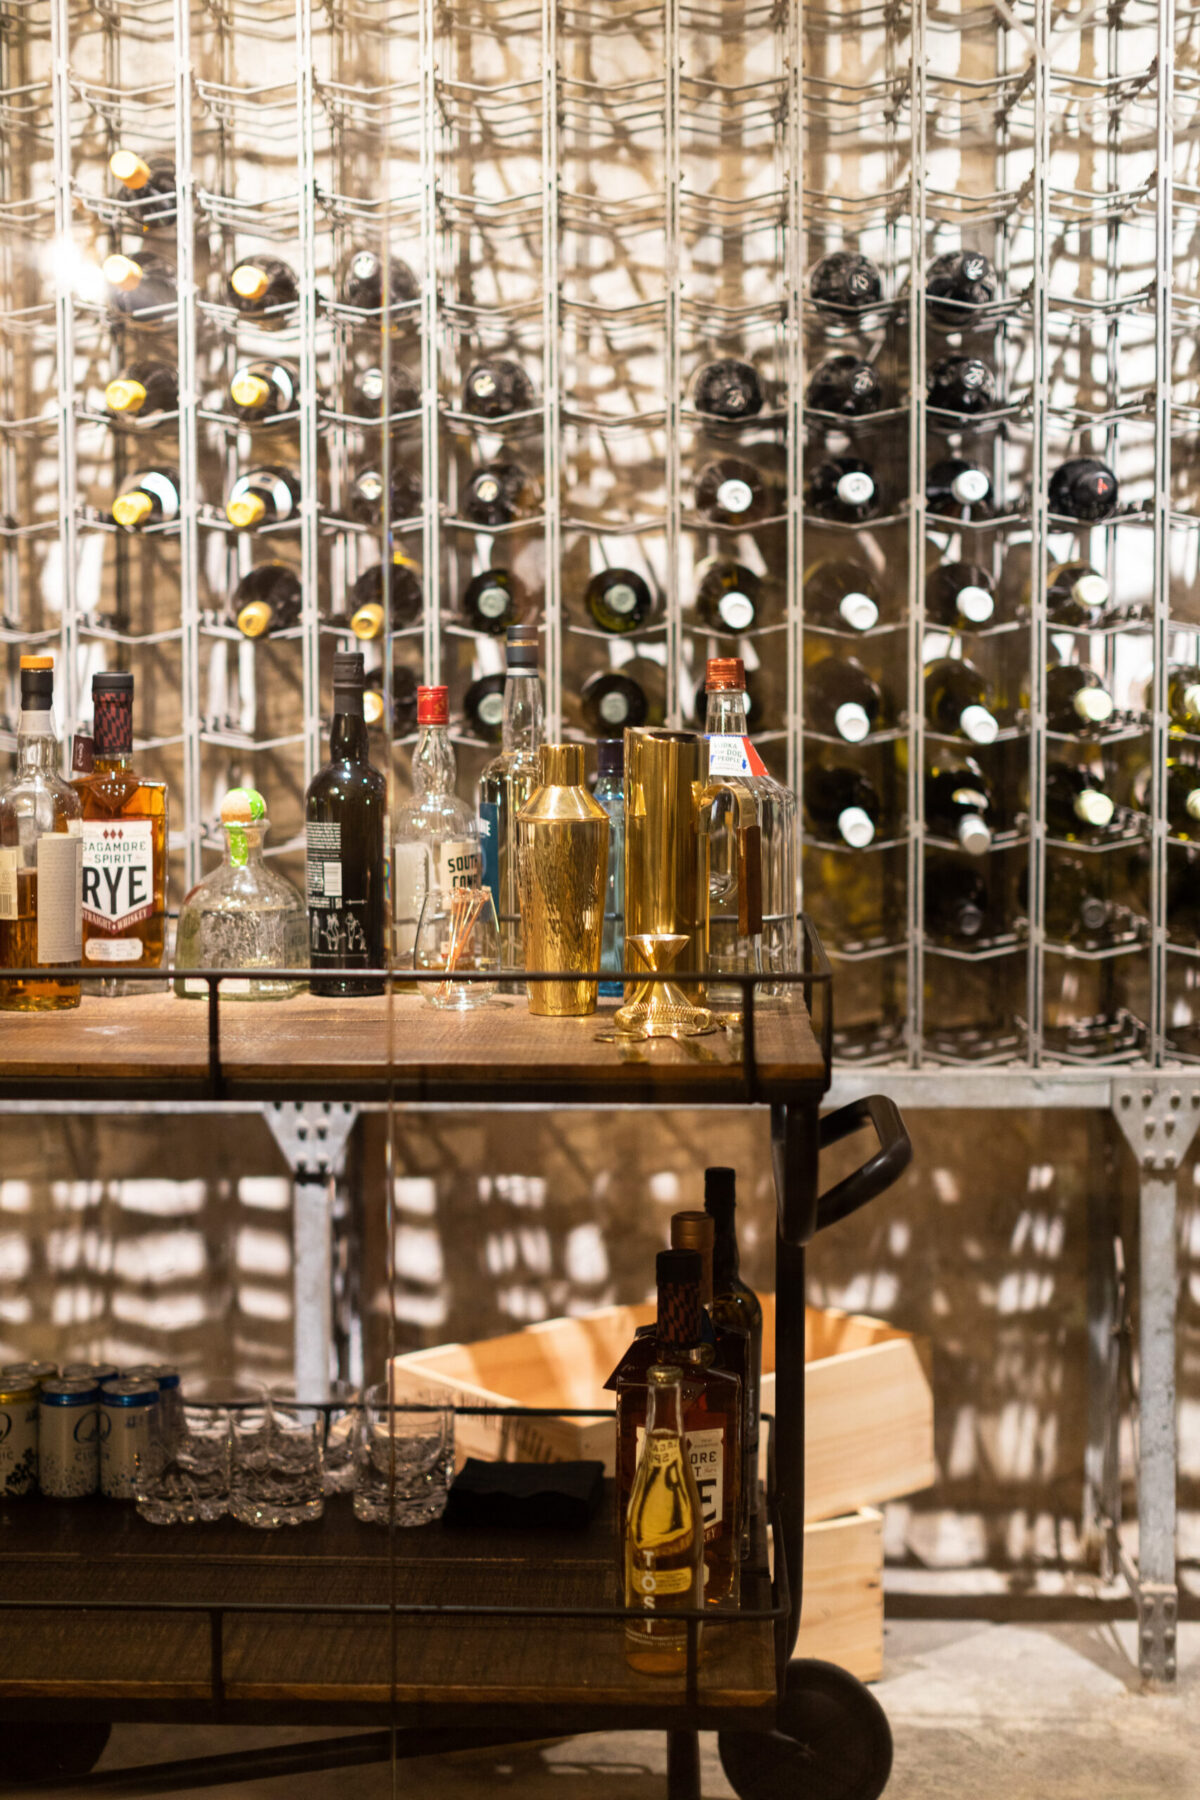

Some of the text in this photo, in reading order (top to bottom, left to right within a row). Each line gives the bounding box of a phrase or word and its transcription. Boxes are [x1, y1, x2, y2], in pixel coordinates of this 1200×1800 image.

[94, 854, 133, 864] SPIRIT
[82, 866, 147, 915] RYE
[117, 908, 147, 931] WHISKEY
[641, 1550, 657, 1634] TÖST
